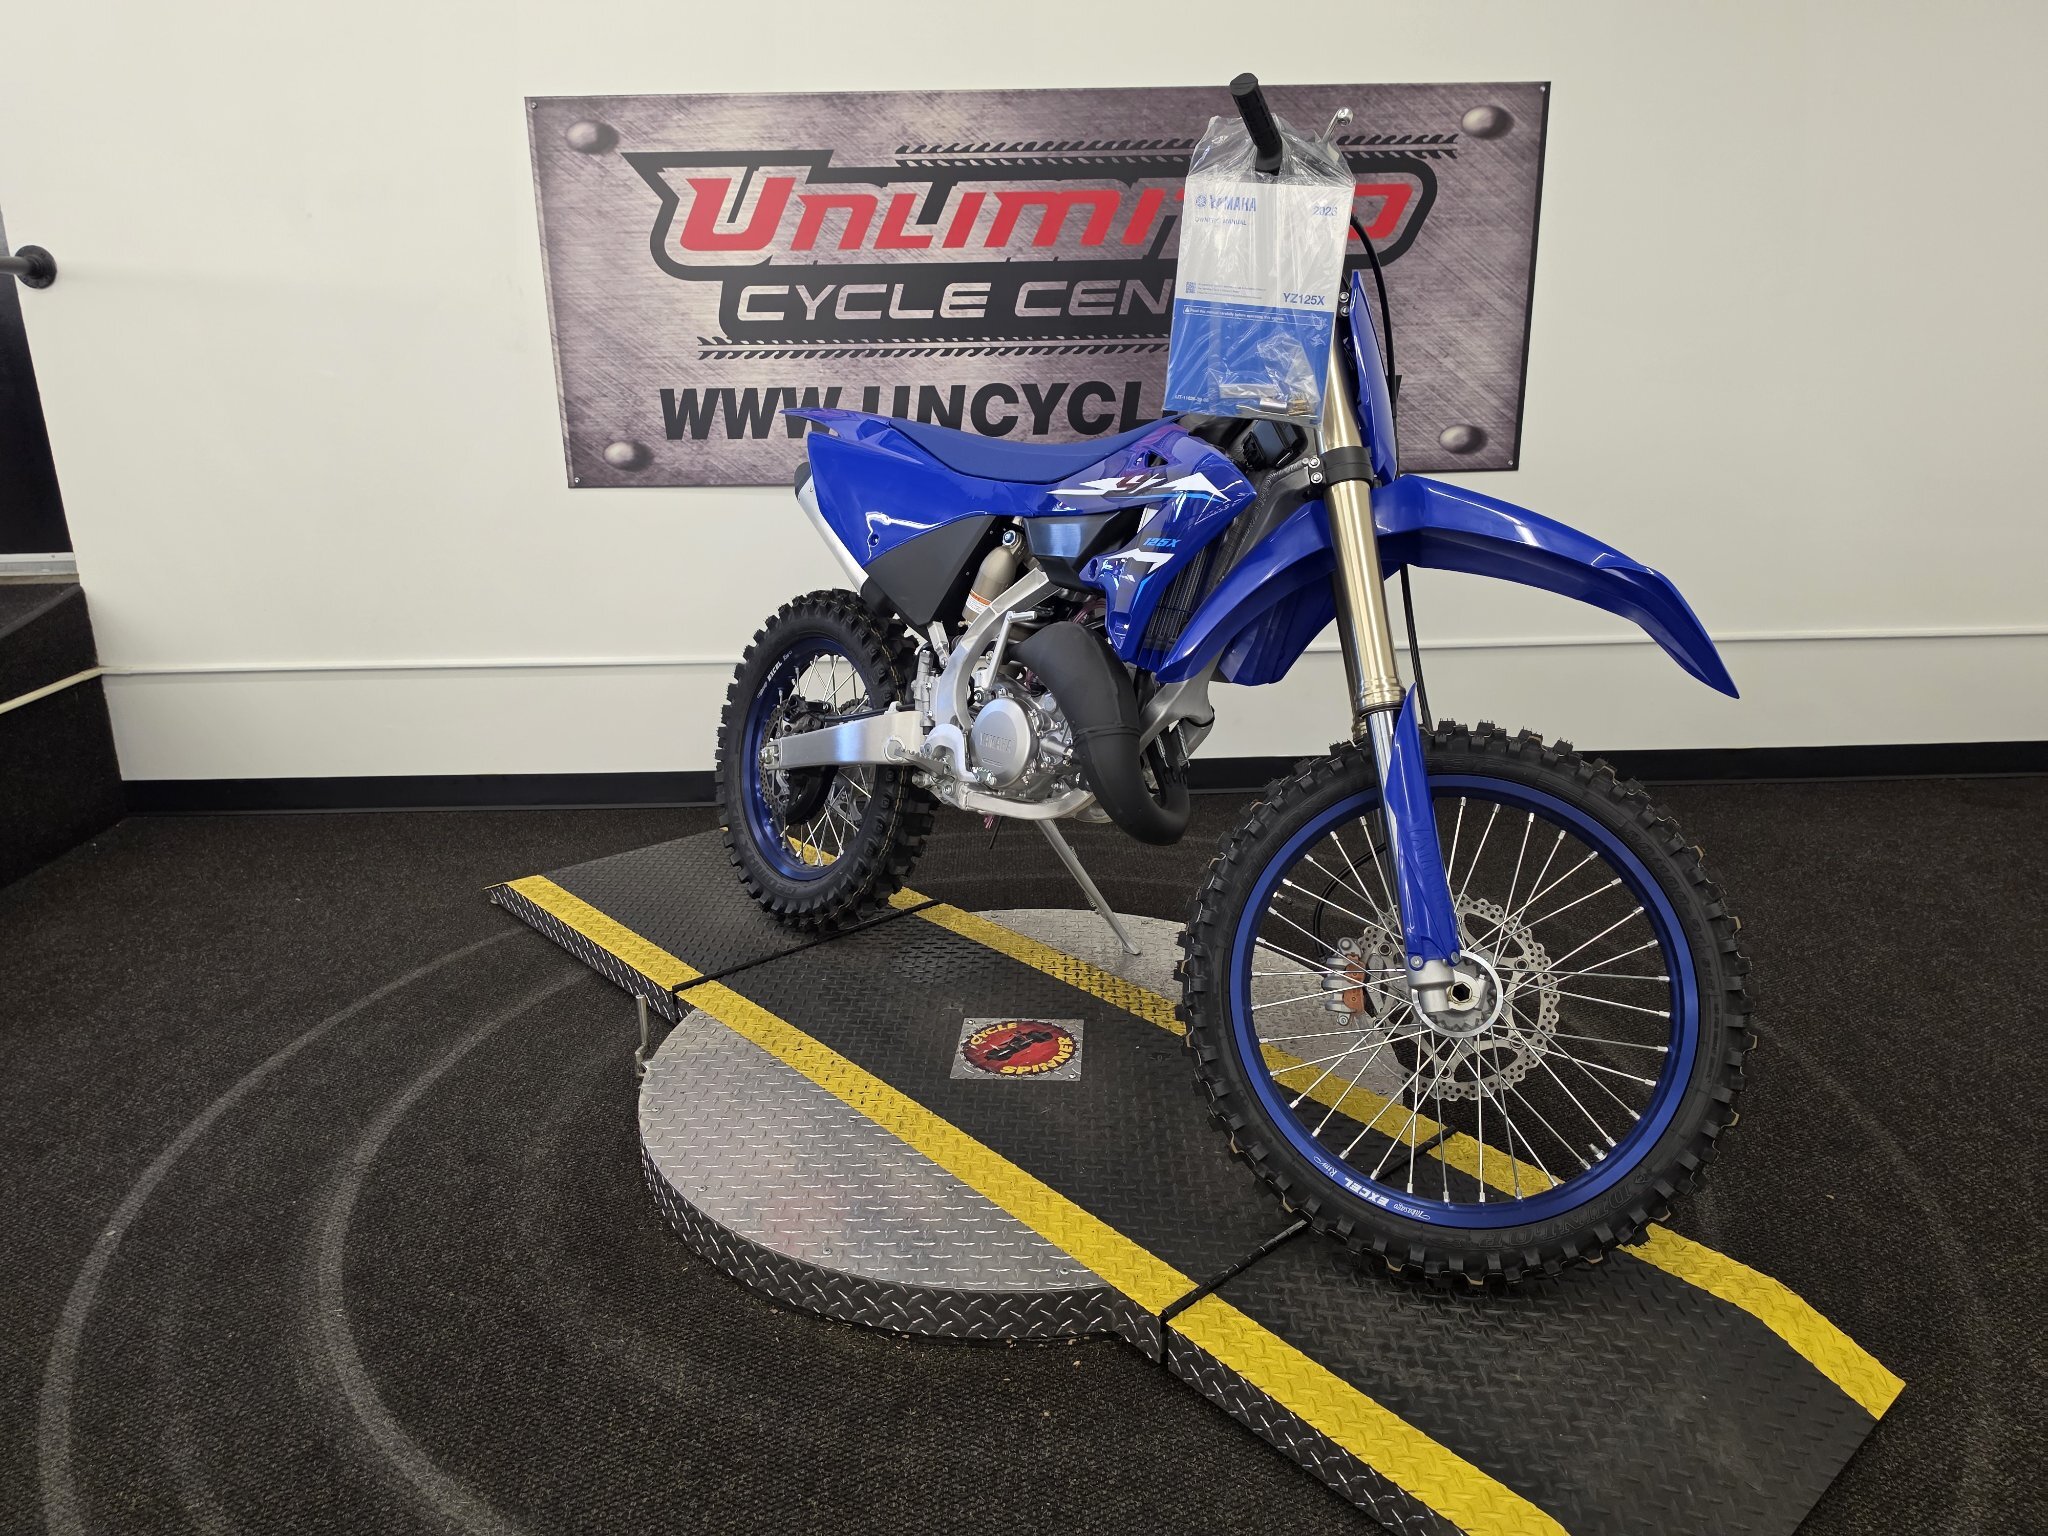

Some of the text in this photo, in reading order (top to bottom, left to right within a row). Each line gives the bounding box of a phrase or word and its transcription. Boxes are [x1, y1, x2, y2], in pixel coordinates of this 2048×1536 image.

[682, 176, 1414, 252] UNLIMID
[736, 282, 992, 321] CYCLE
[1014, 278, 1174, 317] CEN
[1282, 292, 1326, 306] YZ125X
[1143, 537, 1182, 548] 125X
[970, 1022, 1018, 1046] CYCLE
[1000, 1035, 1075, 1075] SPINNER
[1344, 1177, 1390, 1207] EXCEL
[1478, 1186, 1633, 1248] DUNLOP
